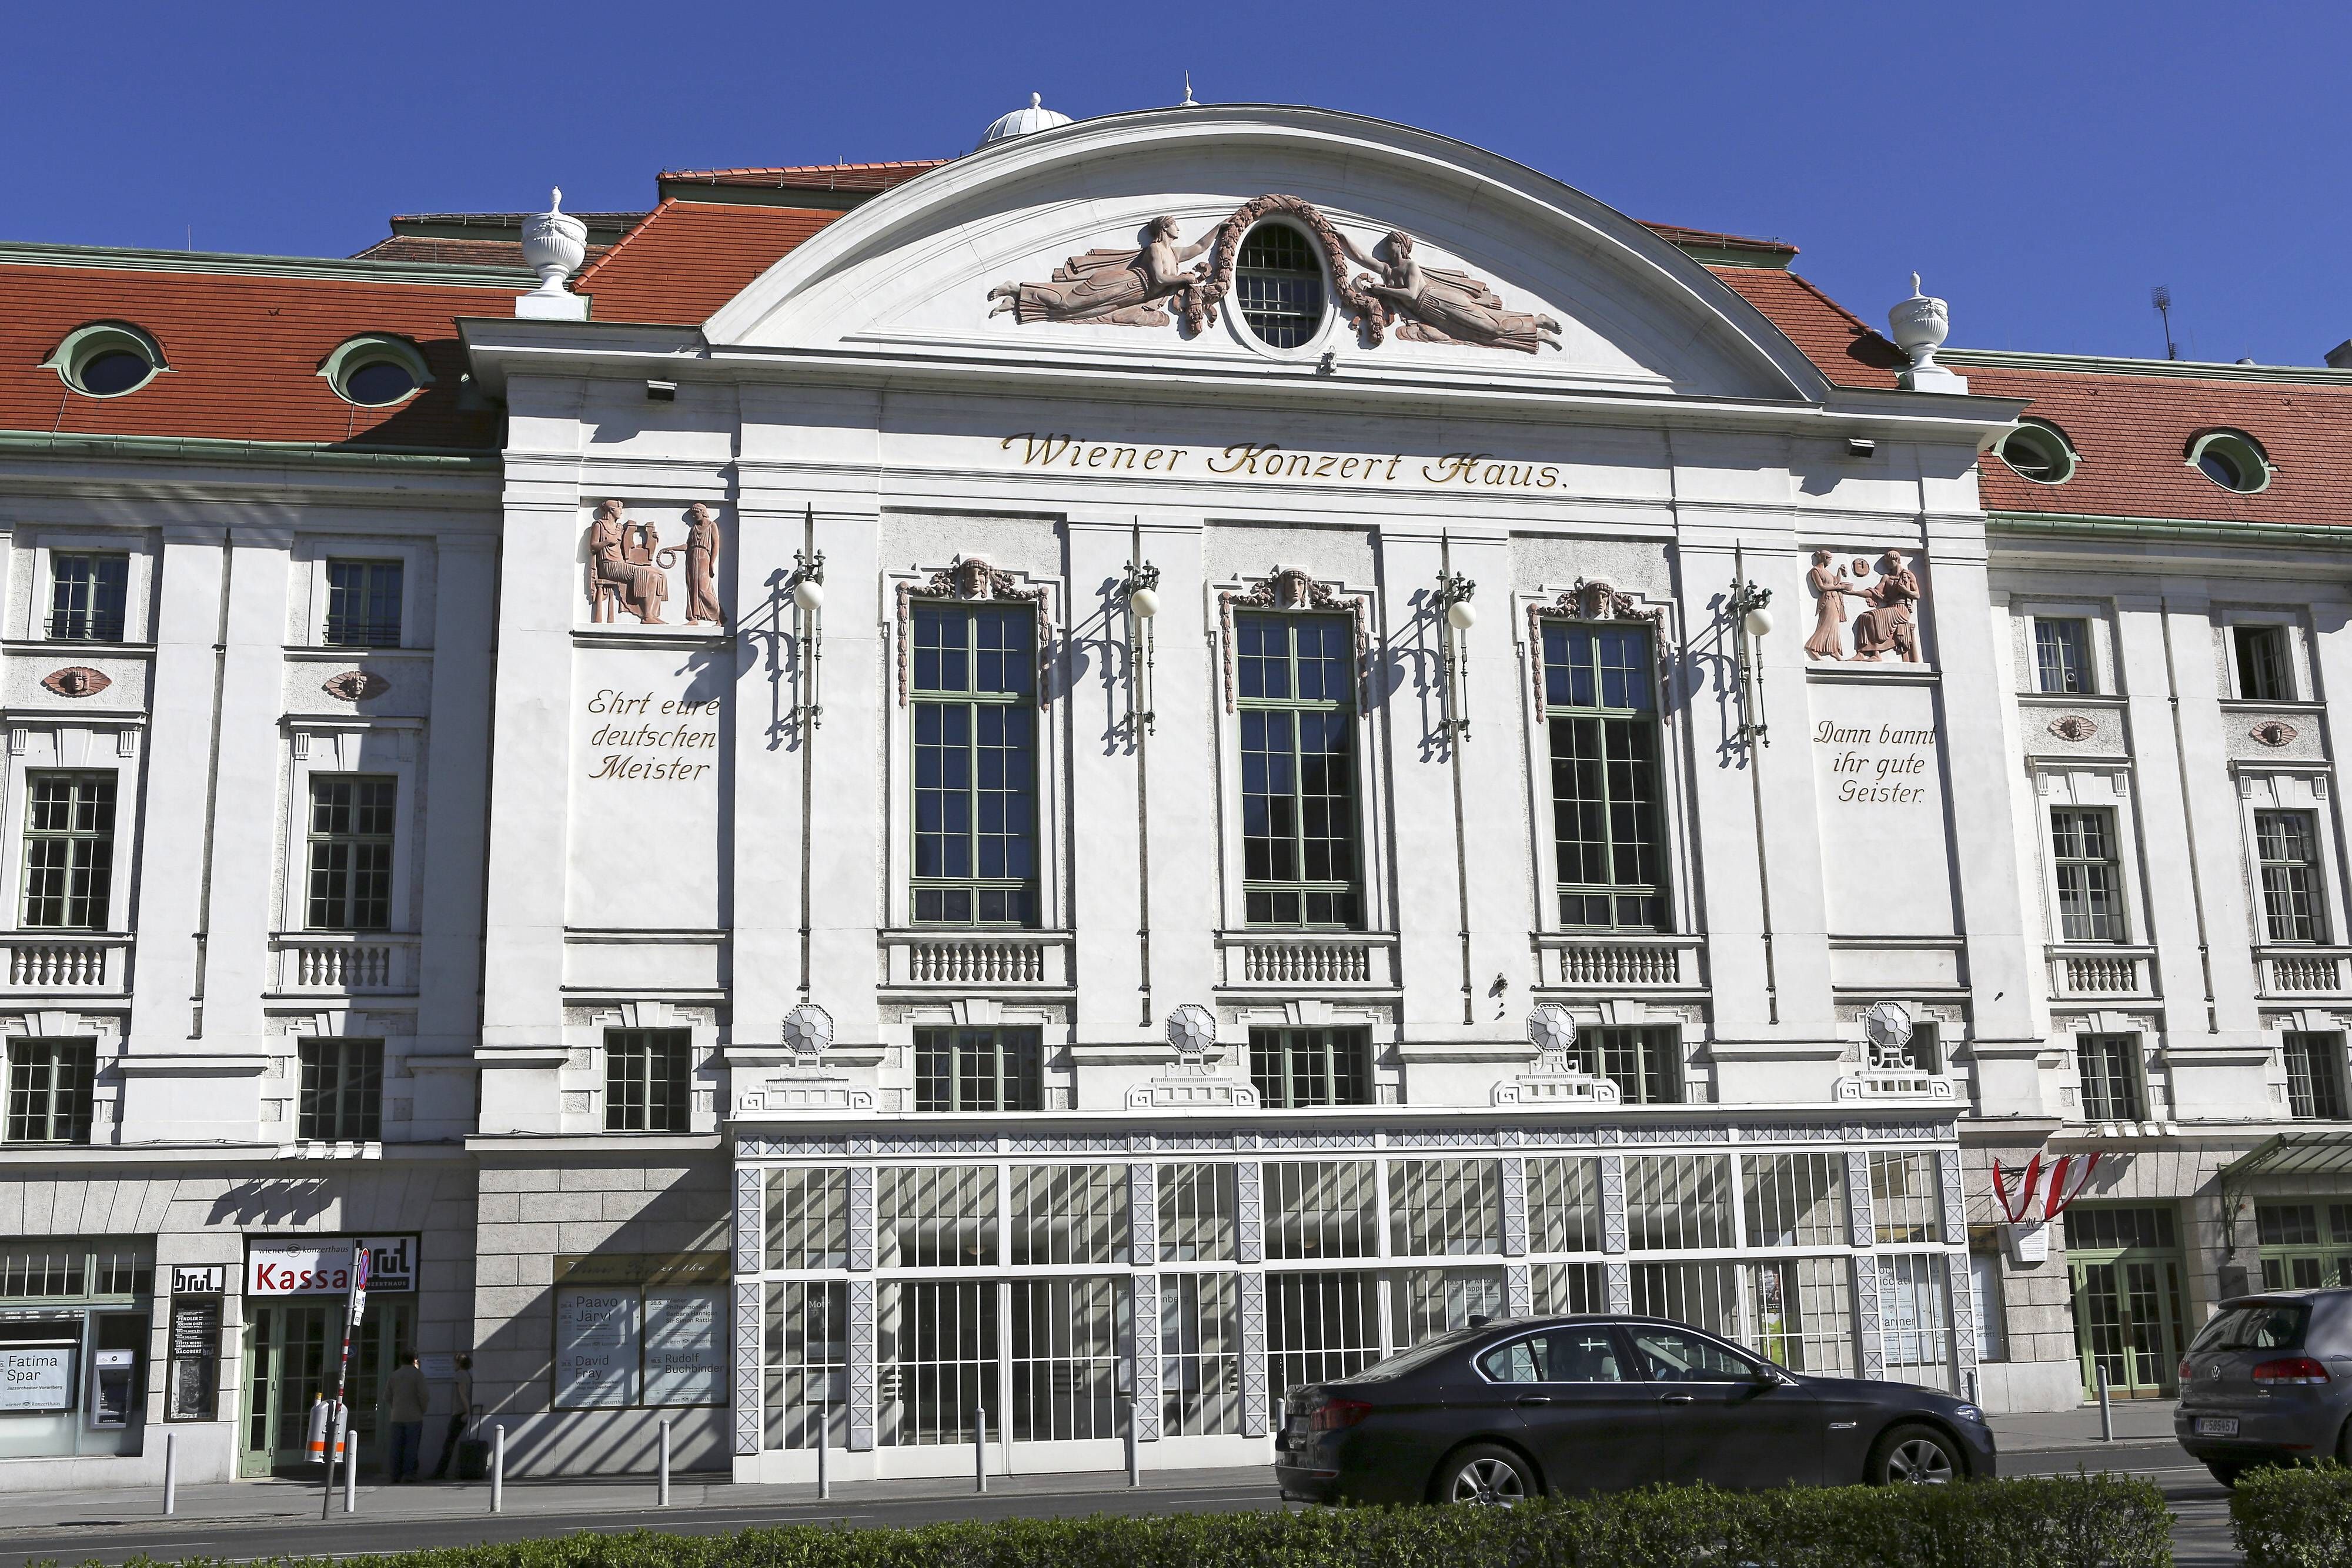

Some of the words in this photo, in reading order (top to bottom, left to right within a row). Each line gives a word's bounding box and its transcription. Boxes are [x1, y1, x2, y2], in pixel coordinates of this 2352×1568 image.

[1000, 432, 1188, 472] Wiener
[1206, 442, 1402, 481] Konzert
[587, 689, 654, 716] Ehrt
[661, 698, 720, 716] eure
[591, 723, 716, 748] deutschen
[1813, 720, 1871, 744] Dann
[1879, 723, 1937, 745] bannt
[587, 754, 710, 781] Meister
[1833, 751, 1869, 773] ihr
[1875, 753, 1925, 781] gute
[1838, 780, 1925, 803] Geister.
[302, 1245, 349, 1254] konzerthaus
[256, 1263, 348, 1290] Kassa
[576, 1296, 618, 1308] Paavo
[576, 1310, 612, 1322] Järvi
[8, 1355, 58, 1367] Fatima
[576, 1355, 609, 1366] David
[665, 1353, 700, 1363] Rudolf
[576, 1368, 602, 1380] Fray
[665, 1363, 725, 1373] Buchbinder
[7, 1369, 41, 1384] Spar
